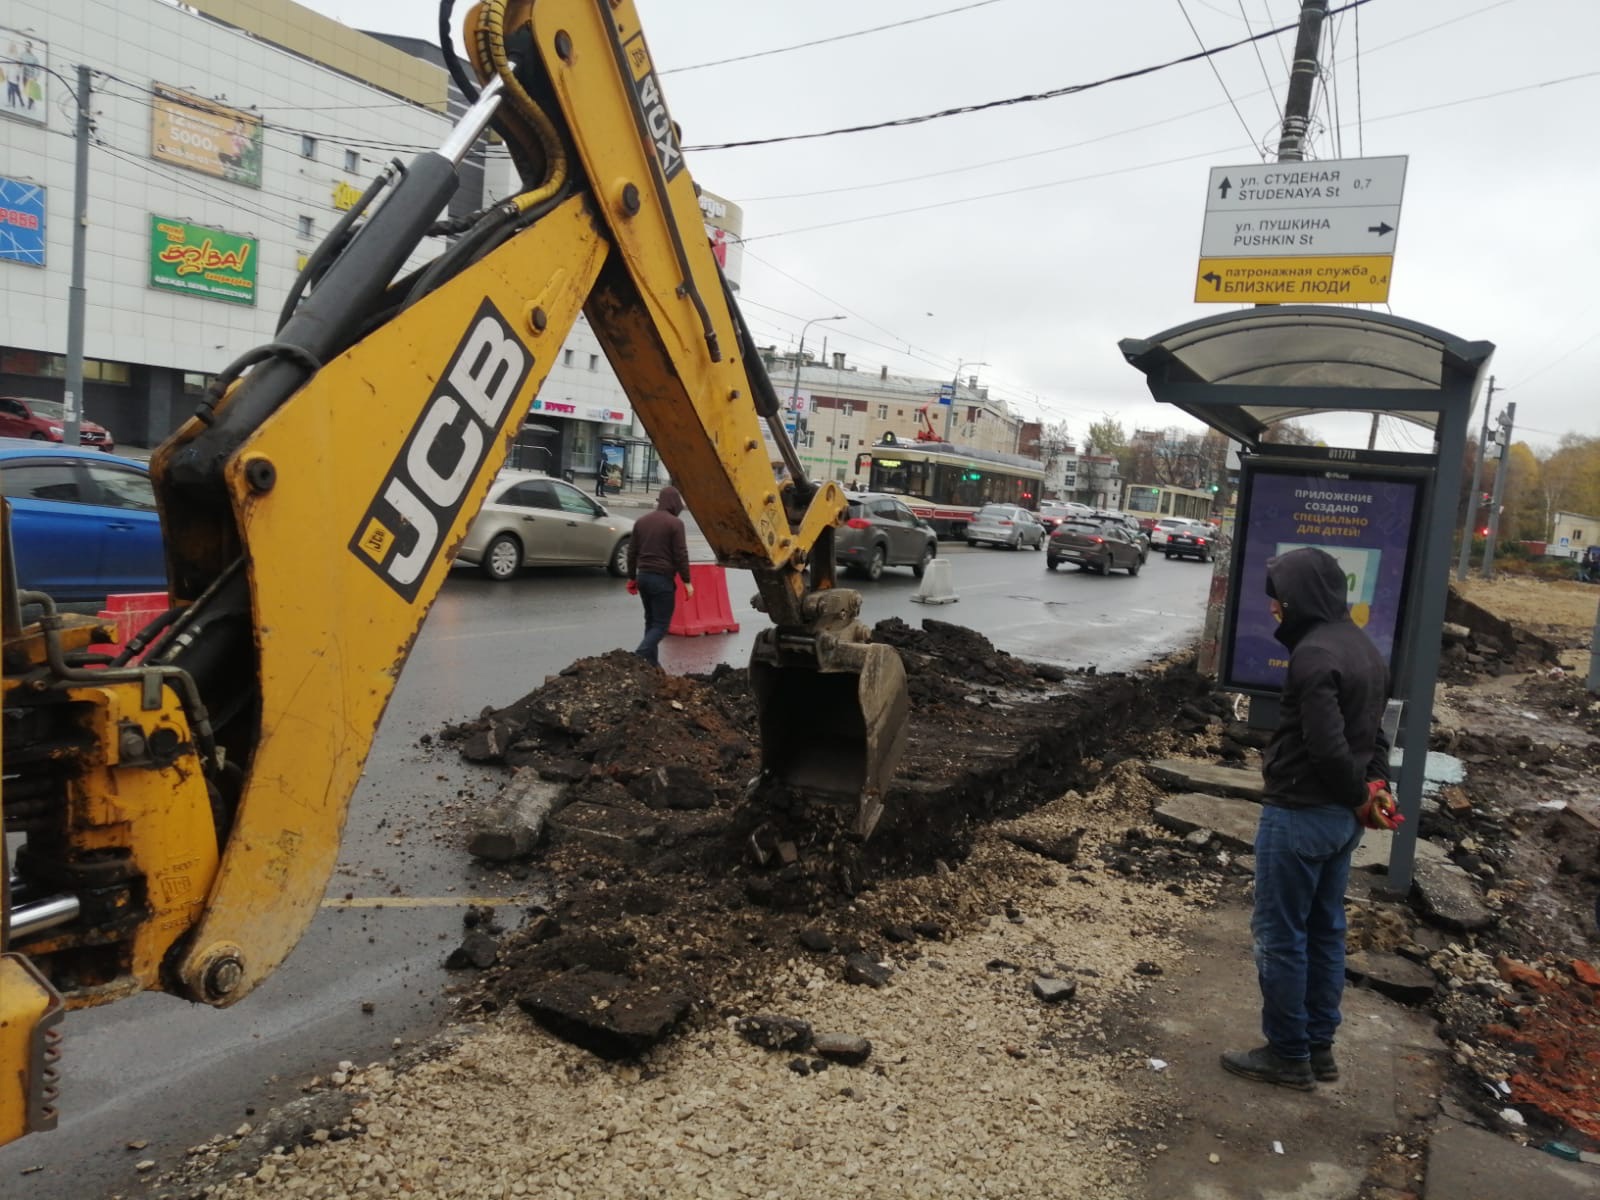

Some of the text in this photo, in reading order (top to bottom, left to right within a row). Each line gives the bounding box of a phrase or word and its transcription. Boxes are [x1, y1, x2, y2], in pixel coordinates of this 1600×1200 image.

[640, 75, 680, 170] 4CX
[1240, 171, 1372, 190] ул. СТУДЕНАЯ 0,7
[1239, 187, 1340, 200] STUDENAYA St
[1235, 218, 1331, 233] ул. ПУШКИНА
[1233, 234, 1313, 246] PUSHKIN St
[1226, 267, 1312, 281] патронажная
[1317, 265, 1368, 280] служба
[1224, 280, 1350, 294] БЛИЗКИЕ ЛЮДИ
[384, 316, 524, 584] JCB
[1294, 489, 1373, 503] ПРИЛОЖЕНИЕ
[1305, 502, 1359, 513] СОЗДАНО
[1293, 512, 1369, 527] СПЕЦИАЛЬНО
[1296, 524, 1361, 537] ДЛЯ ДЕТЕЙ!
[369, 530, 385, 550] JCB
